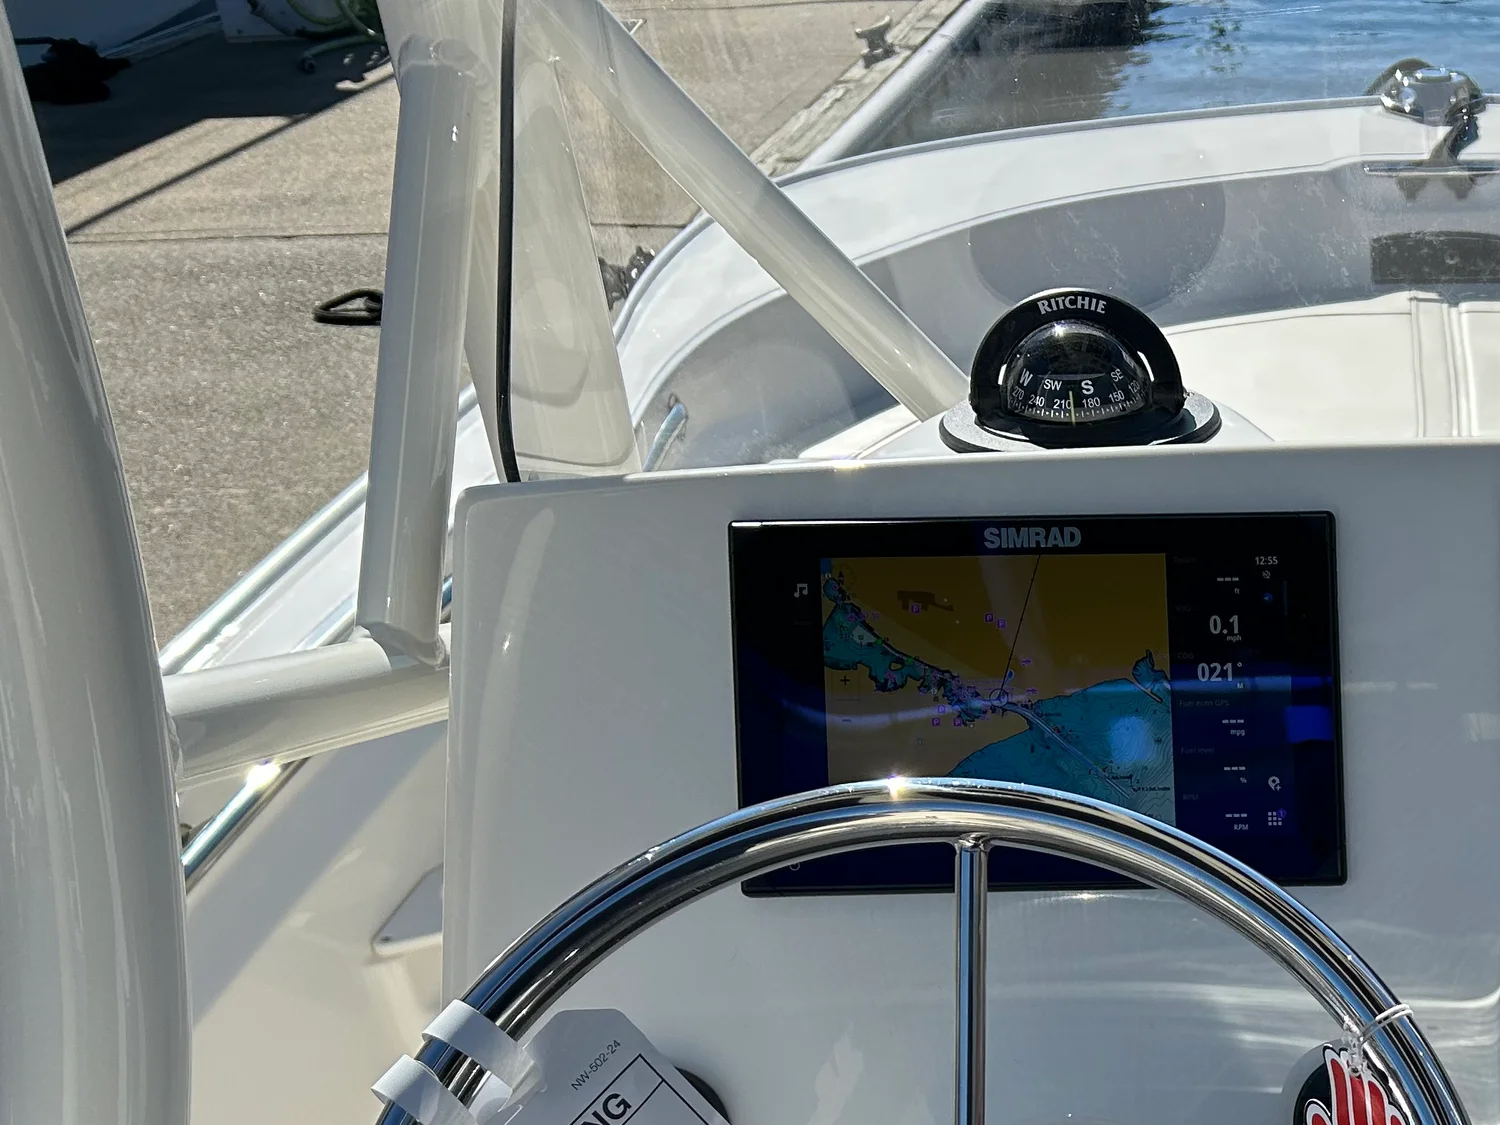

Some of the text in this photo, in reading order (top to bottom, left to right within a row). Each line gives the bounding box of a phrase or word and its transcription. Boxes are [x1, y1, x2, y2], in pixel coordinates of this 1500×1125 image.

[1037, 296, 1107, 314] RITCHIE
[1020, 368, 1124, 394] W SW S SE
[1013, 380, 1141, 410] 270 240 210 180 150 120
[984, 526, 1082, 549] SIMRAD
[1255, 555, 1278, 566] 12:55
[1234, 587, 1241, 595] ft
[1209, 615, 1239, 634] 0.1
[1226, 634, 1242, 644] mph
[1230, 727, 1246, 737] mpg
[1234, 824, 1249, 832] RPM
[570, 1039, 621, 1090] NW-502-24
